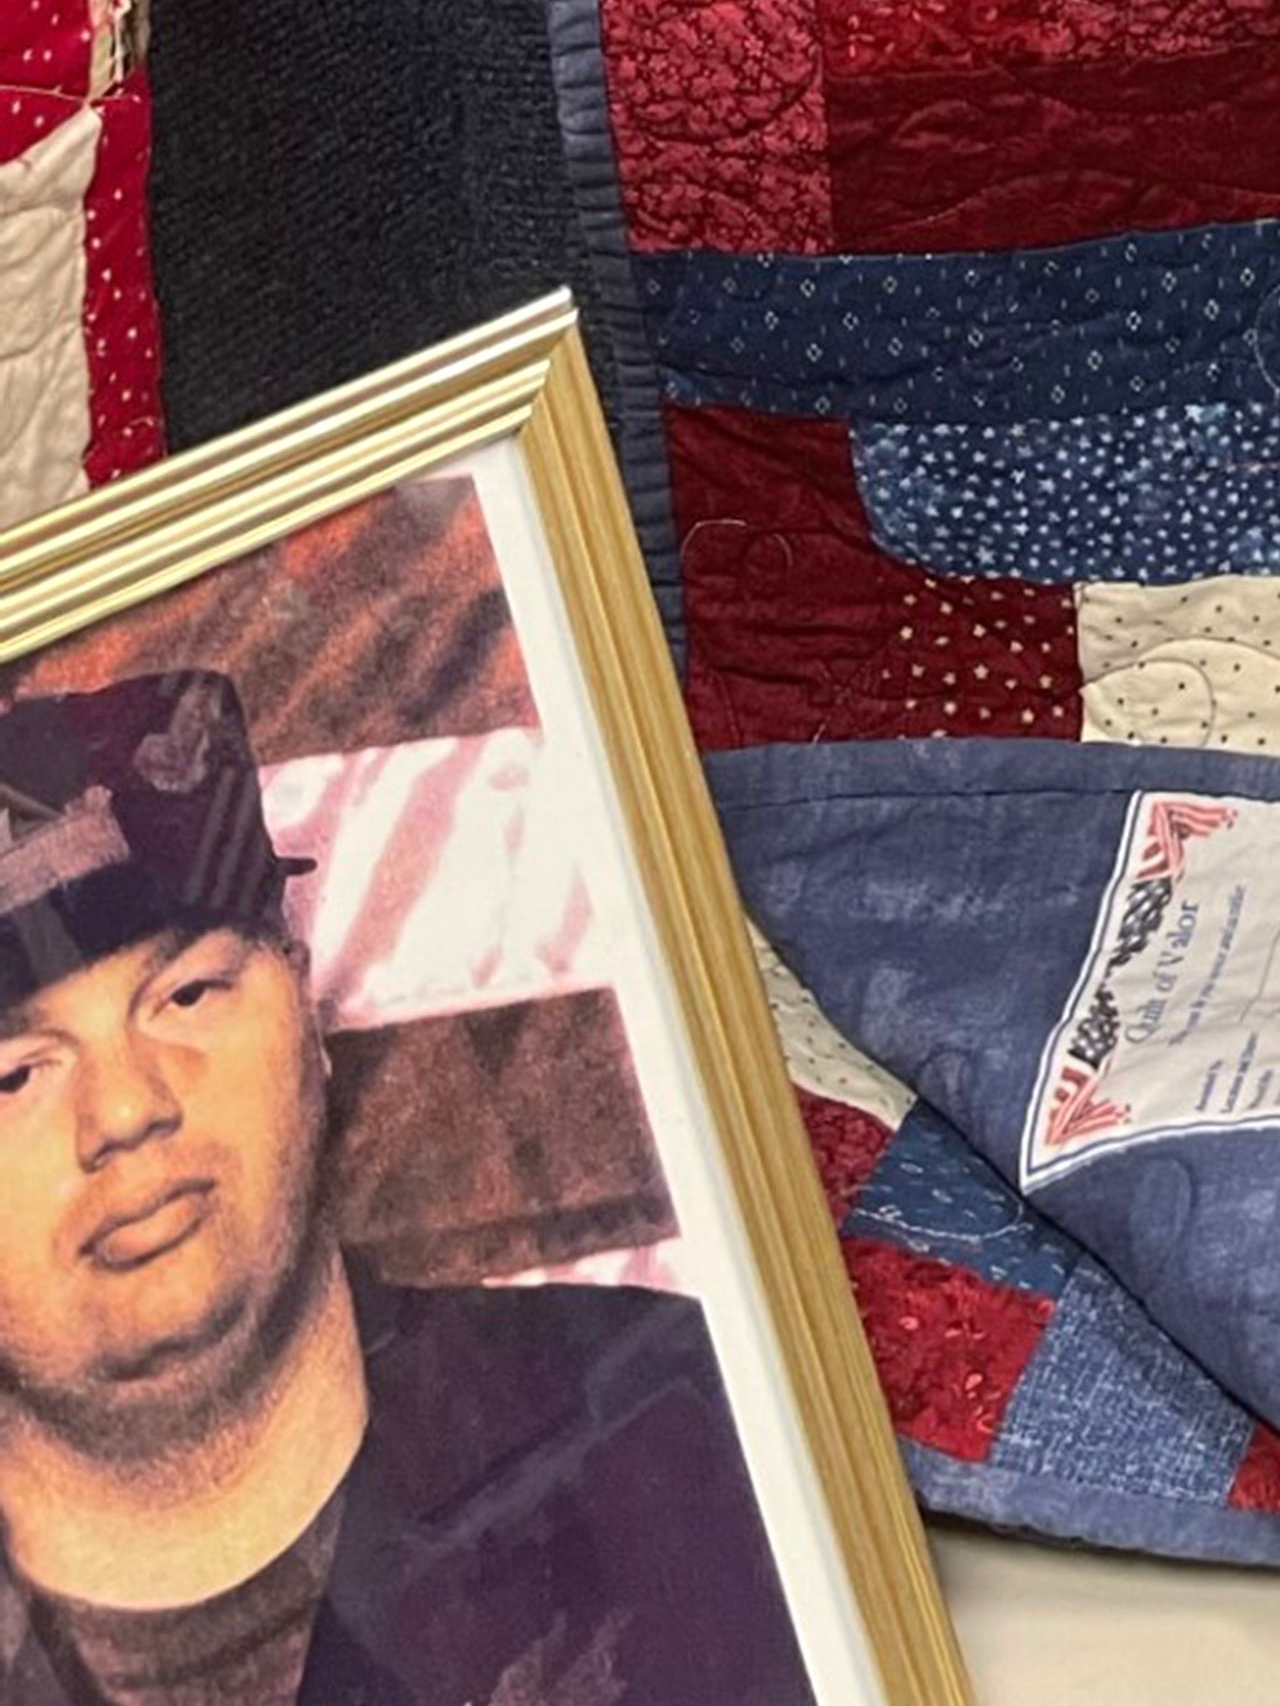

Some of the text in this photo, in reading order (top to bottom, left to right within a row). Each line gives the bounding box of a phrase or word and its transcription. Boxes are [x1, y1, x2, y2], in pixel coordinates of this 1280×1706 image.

[1125, 900, 1199, 1044] Quilt of Valor
